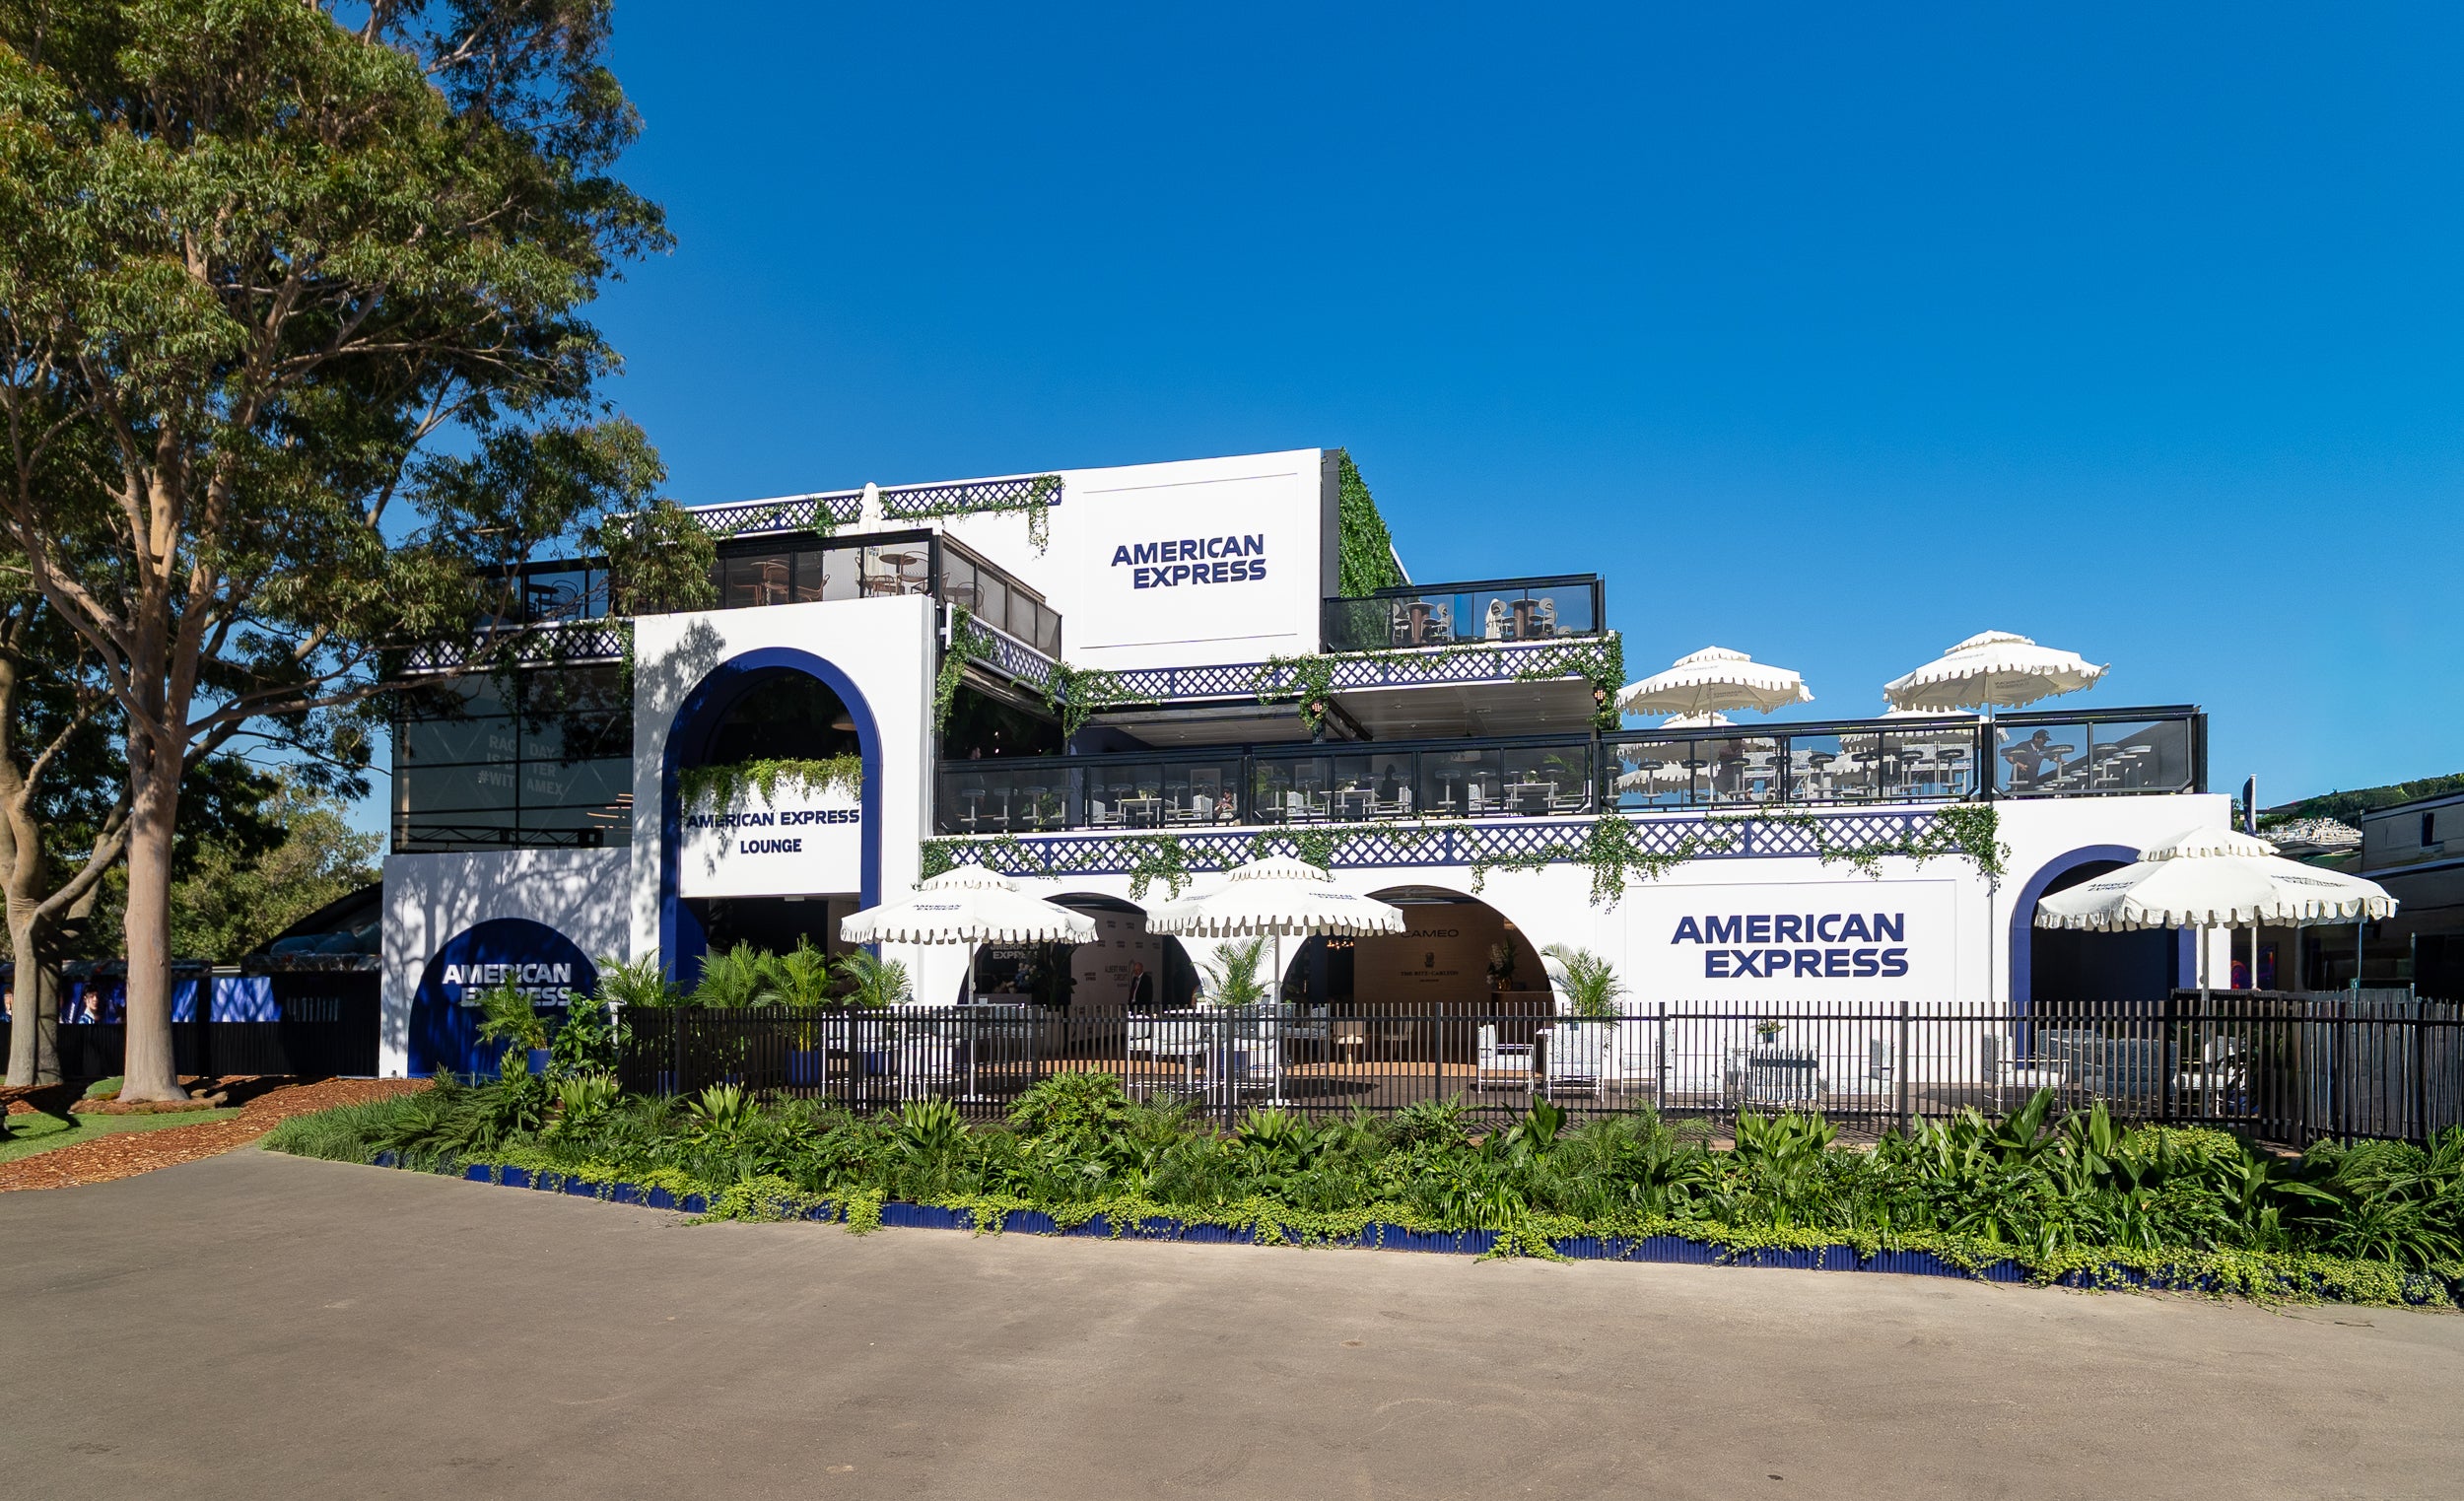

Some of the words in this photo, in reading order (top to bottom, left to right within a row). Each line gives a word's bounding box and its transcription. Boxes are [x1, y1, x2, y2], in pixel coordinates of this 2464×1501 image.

[1111, 533, 1264, 567] AMERICAN
[1133, 558, 1266, 589] EXPRESS
[489, 734, 517, 753] RAC
[477, 770, 516, 787] #WIT
[526, 778, 563, 795] AMEX
[686, 812, 775, 829] AMERICAN
[780, 809, 860, 826] EXPRESS
[740, 839, 802, 854] LOUNGE
[1401, 928, 1460, 938] CAMEO
[1671, 913, 1905, 944] AMERICAN
[442, 963, 572, 985] AMERICAN
[1705, 948, 1909, 978] EXPRESS
